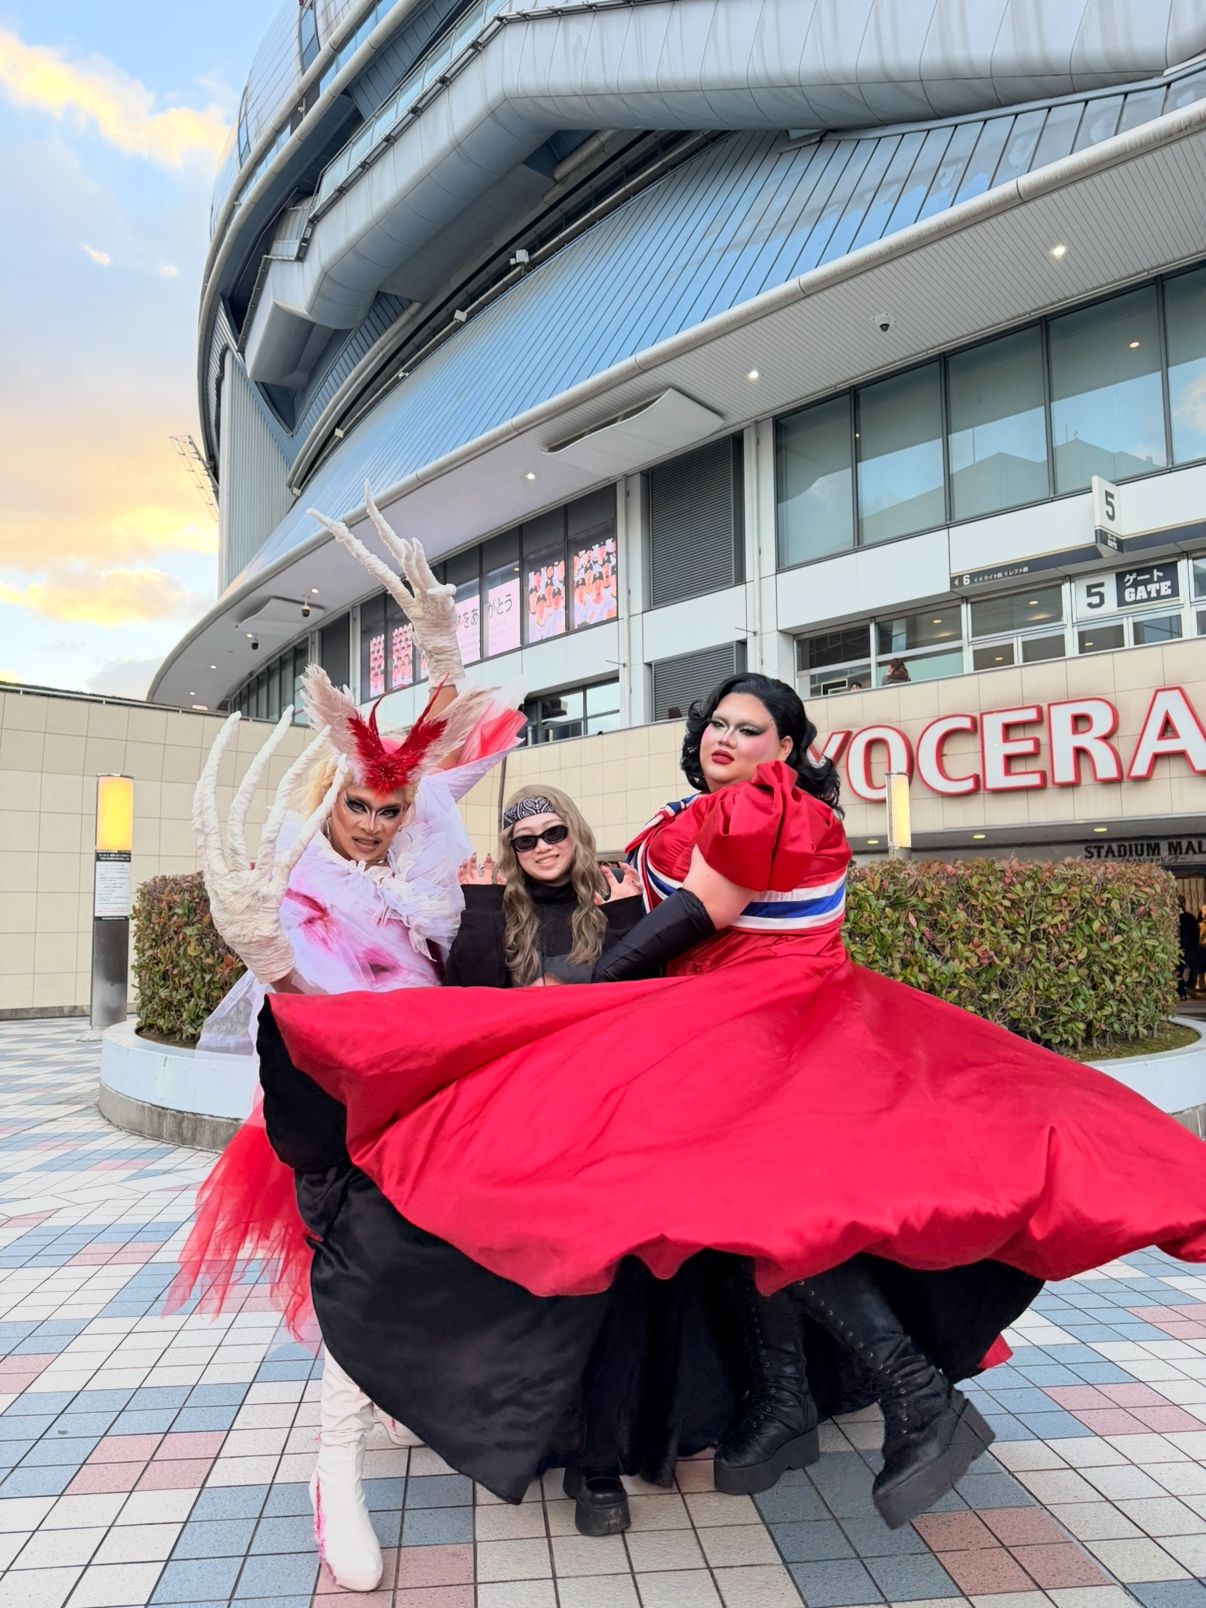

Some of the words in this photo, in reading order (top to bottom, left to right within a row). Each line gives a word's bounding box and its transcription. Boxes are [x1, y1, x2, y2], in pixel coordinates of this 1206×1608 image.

[1105, 490, 1115, 521] 5
[963, 574, 970, 585] 6
[1124, 569, 1164, 587] ゲート
[1086, 582, 1105, 609] 5
[1124, 581, 1172, 602] GATE
[1084, 842, 1161, 859] STADIUM
